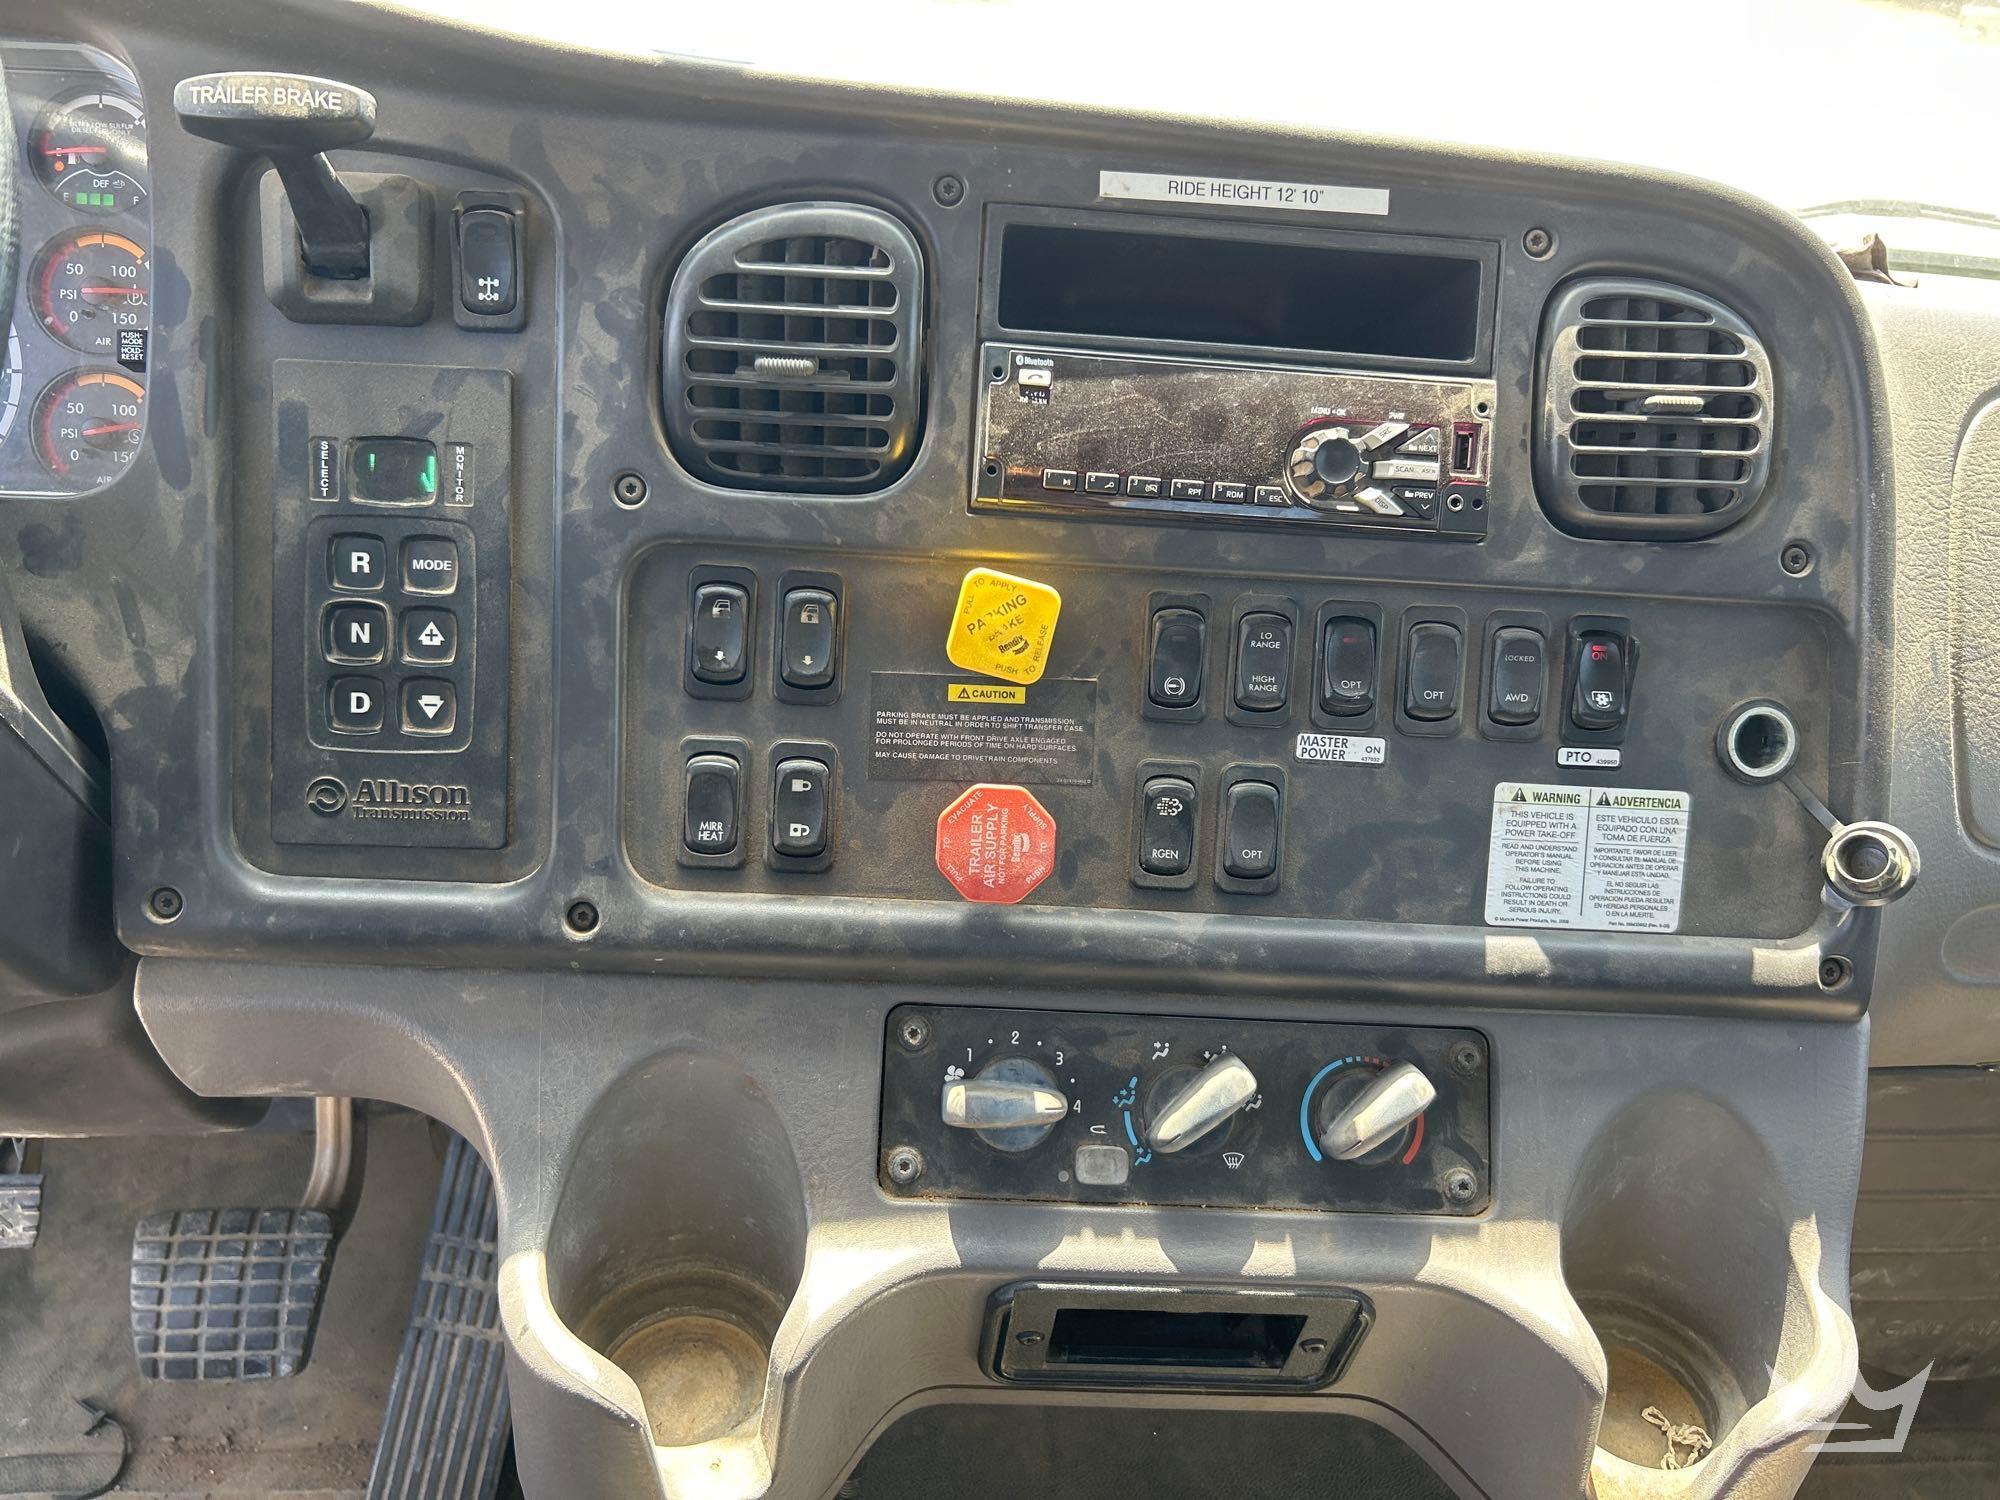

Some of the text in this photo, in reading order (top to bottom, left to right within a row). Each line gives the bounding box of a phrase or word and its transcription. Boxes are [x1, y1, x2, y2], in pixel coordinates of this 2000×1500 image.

[189, 86, 342, 110] TRAILER BRAKE
[1168, 181, 1324, 203] RIDE HEIGHT 12' 10"
[66, 264, 84, 275] 50
[111, 266, 136, 278] 100
[60, 290, 77, 300] PSI
[70, 311, 78, 322] 0
[112, 313, 137, 324] 150
[1024, 356, 1054, 366] Bluetooth
[67, 403, 84, 414] 50
[112, 405, 137, 416] 100
[61, 428, 78, 438] PSI
[1380, 427, 1392, 438] SRC
[70, 450, 78, 461] 0
[320, 440, 328, 496] SELECT
[456, 446, 464, 502] MONITOR
[1375, 497, 1388, 510] DISP
[351, 552, 370, 573] R
[412, 559, 452, 571] MODE
[964, 578, 1017, 614] PULL TO APPLY
[351, 623, 370, 644] N
[995, 624, 1049, 676] PUSH TO RELEASE
[998, 635, 1024, 654] Bendix
[1250, 641, 1280, 649] RANGE
[1592, 652, 1607, 661] ON
[1252, 675, 1275, 684] HIGH
[1341, 681, 1362, 689] OPT
[1249, 684, 1278, 692] RANGE
[972, 690, 1016, 699] CAUTION
[1424, 691, 1444, 700] OPT
[1505, 694, 1528, 702] AWD
[350, 692, 370, 713] D
[1300, 736, 1349, 748] MASTER
[1301, 747, 1346, 760] POWER
[1566, 752, 1591, 762] PTO
[352, 779, 470, 805] Allison
[1533, 792, 1580, 804] WARNING
[948, 790, 984, 824] EVACUATE
[1613, 796, 1681, 809] ADVERTENCIA
[353, 806, 470, 820] Transmission
[1506, 820, 1547, 828] EQUIPPED
[1617, 816, 1658, 824] VEHICULO
[700, 822, 723, 831] MIRR
[1000, 808, 1009, 845] PARKING
[1597, 824, 1638, 833] EQUIPADO
[698, 831, 724, 841] HEAT
[1537, 830, 1575, 838] TAKE-OFF
[968, 814, 983, 875] TRAILER
[983, 803, 998, 888] AIR SUPPLY
[1023, 804, 1048, 884] PUSH TO SUPPLY
[999, 848, 1007, 865] FOR
[1152, 849, 1178, 860] RGEN
[1242, 850, 1262, 859] OPT
[1011, 1031, 1020, 1044] 2
[967, 1048, 972, 1062] 1
[1056, 1052, 1063, 1065] 3
[1073, 1100, 1081, 1113] 4
